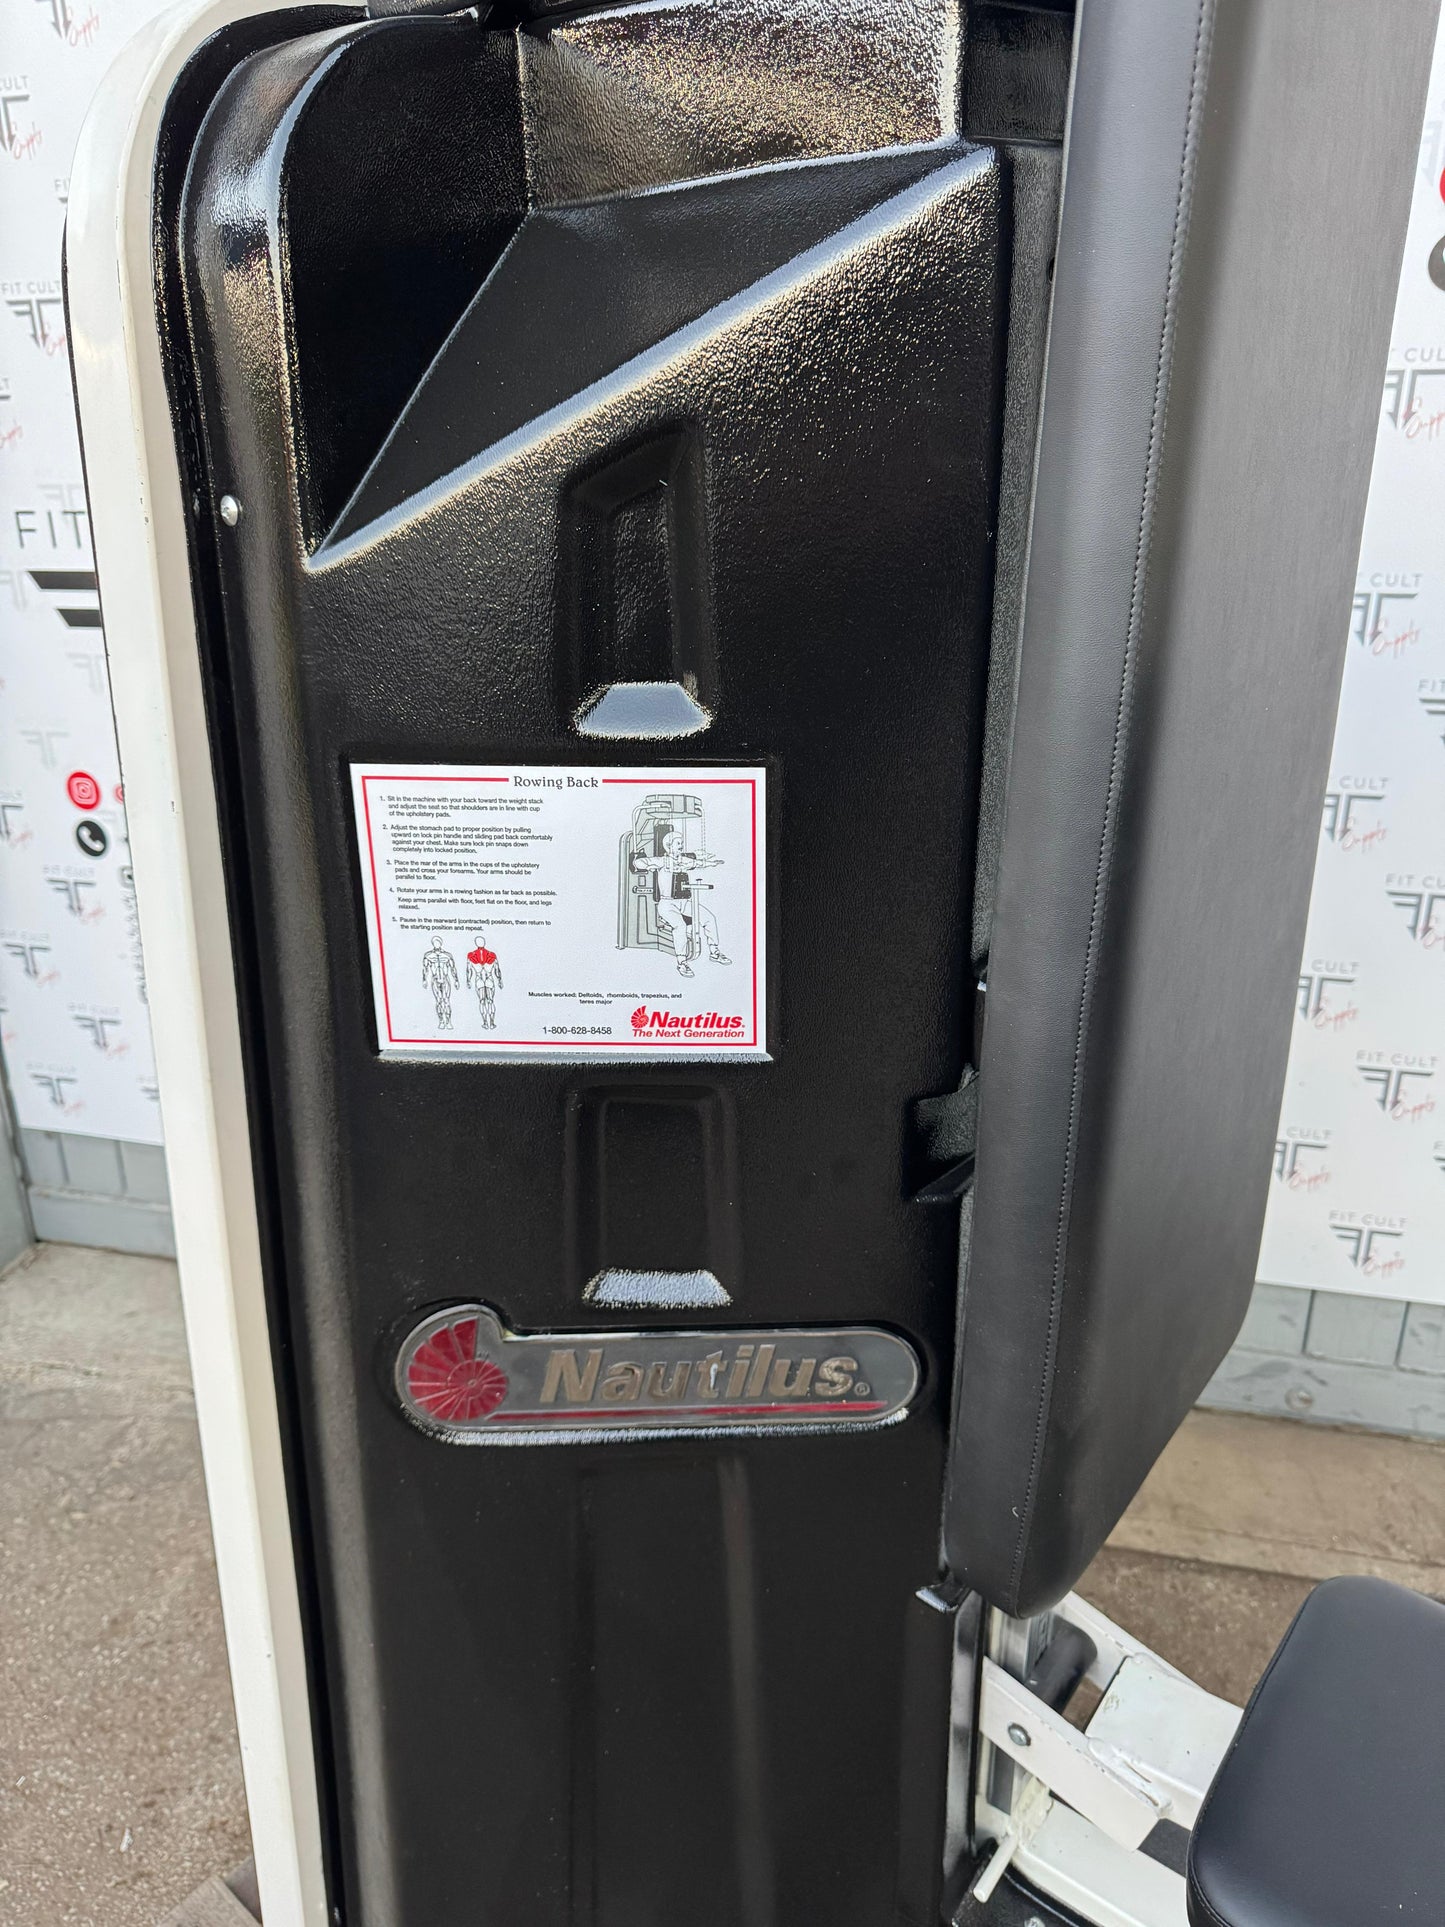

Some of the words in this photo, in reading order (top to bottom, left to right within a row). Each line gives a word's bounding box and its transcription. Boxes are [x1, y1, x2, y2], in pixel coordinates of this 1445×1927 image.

[15, 510, 86, 549] FIT
[1369, 572, 1423, 588] CULT
[513, 776, 563, 790] Rowing
[566, 776, 599, 788] Back
[1338, 775, 1389, 790] CULT
[542, 1026, 612, 1035] 1-800-628-8458
[633, 1028, 652, 1037] The
[655, 1028, 681, 1038] Next
[683, 1028, 744, 1038] Generation
